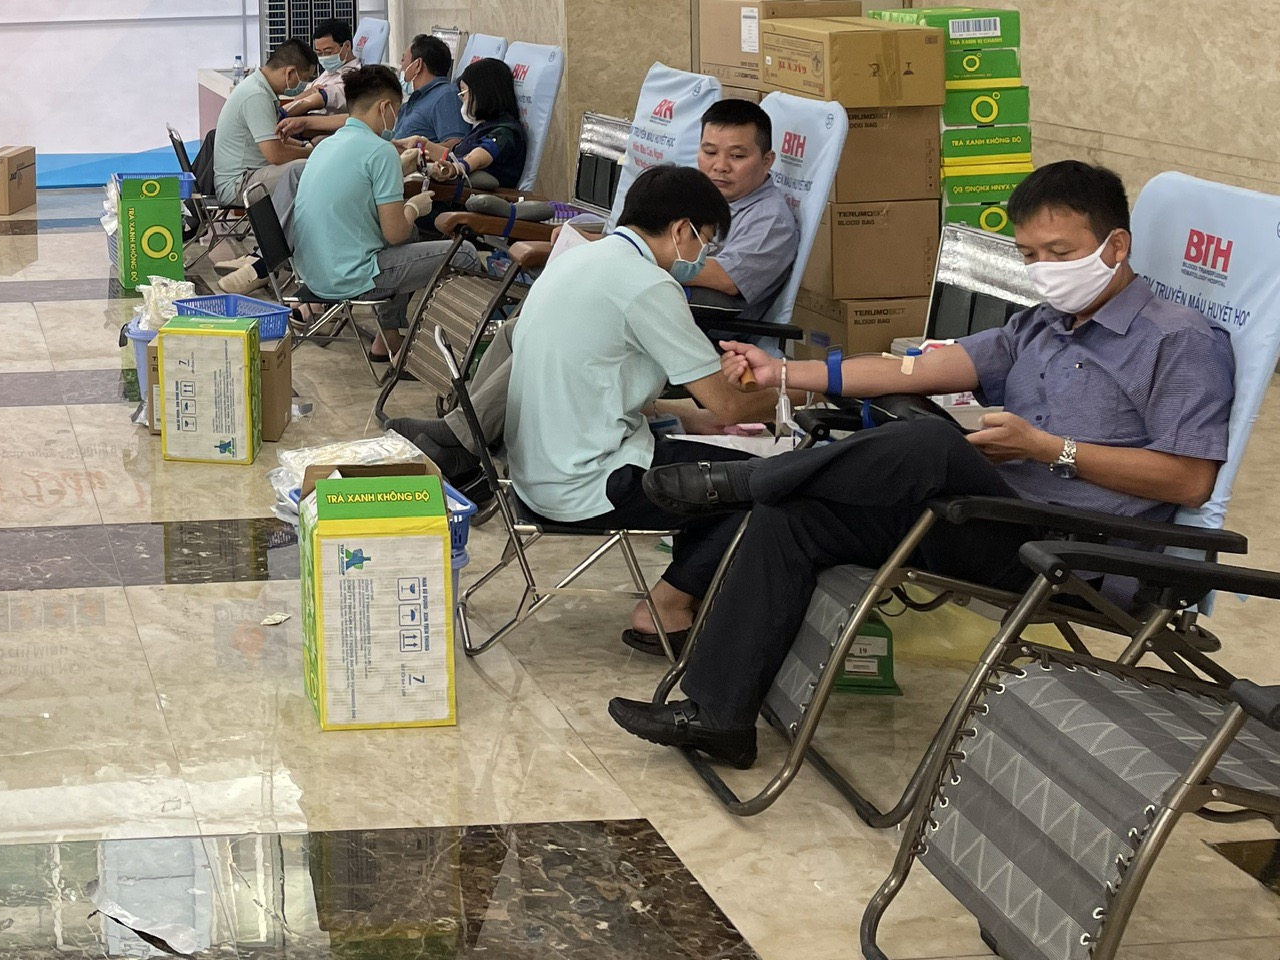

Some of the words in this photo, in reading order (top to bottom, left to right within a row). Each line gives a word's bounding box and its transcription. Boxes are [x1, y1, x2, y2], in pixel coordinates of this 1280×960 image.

[513, 63, 530, 82] BTH
[848, 112, 893, 121] ERUMOBCT
[781, 131, 807, 159] BTH
[951, 139, 964, 147] TRÀ
[966, 137, 985, 145] XANH
[986, 136, 1010, 144] KHÔNG
[1012, 135, 1022, 143] ĐỘ
[130, 244, 138, 269] KHÔNG
[1183, 228, 1234, 273] BTH
[1182, 261, 1198, 271] BLOOD
[131, 271, 138, 282] ĐỘ
[1154, 282, 1187, 306] TRUYỀN
[1188, 292, 1207, 314] MÁU
[1207, 301, 1233, 324] HUYẾT
[327, 491, 344, 504] TRÀ
[347, 493, 375, 503] XANH
[377, 490, 413, 503] KHÔNG
[415, 489, 430, 503] ĐỘ
[412, 675, 425, 684] 7
